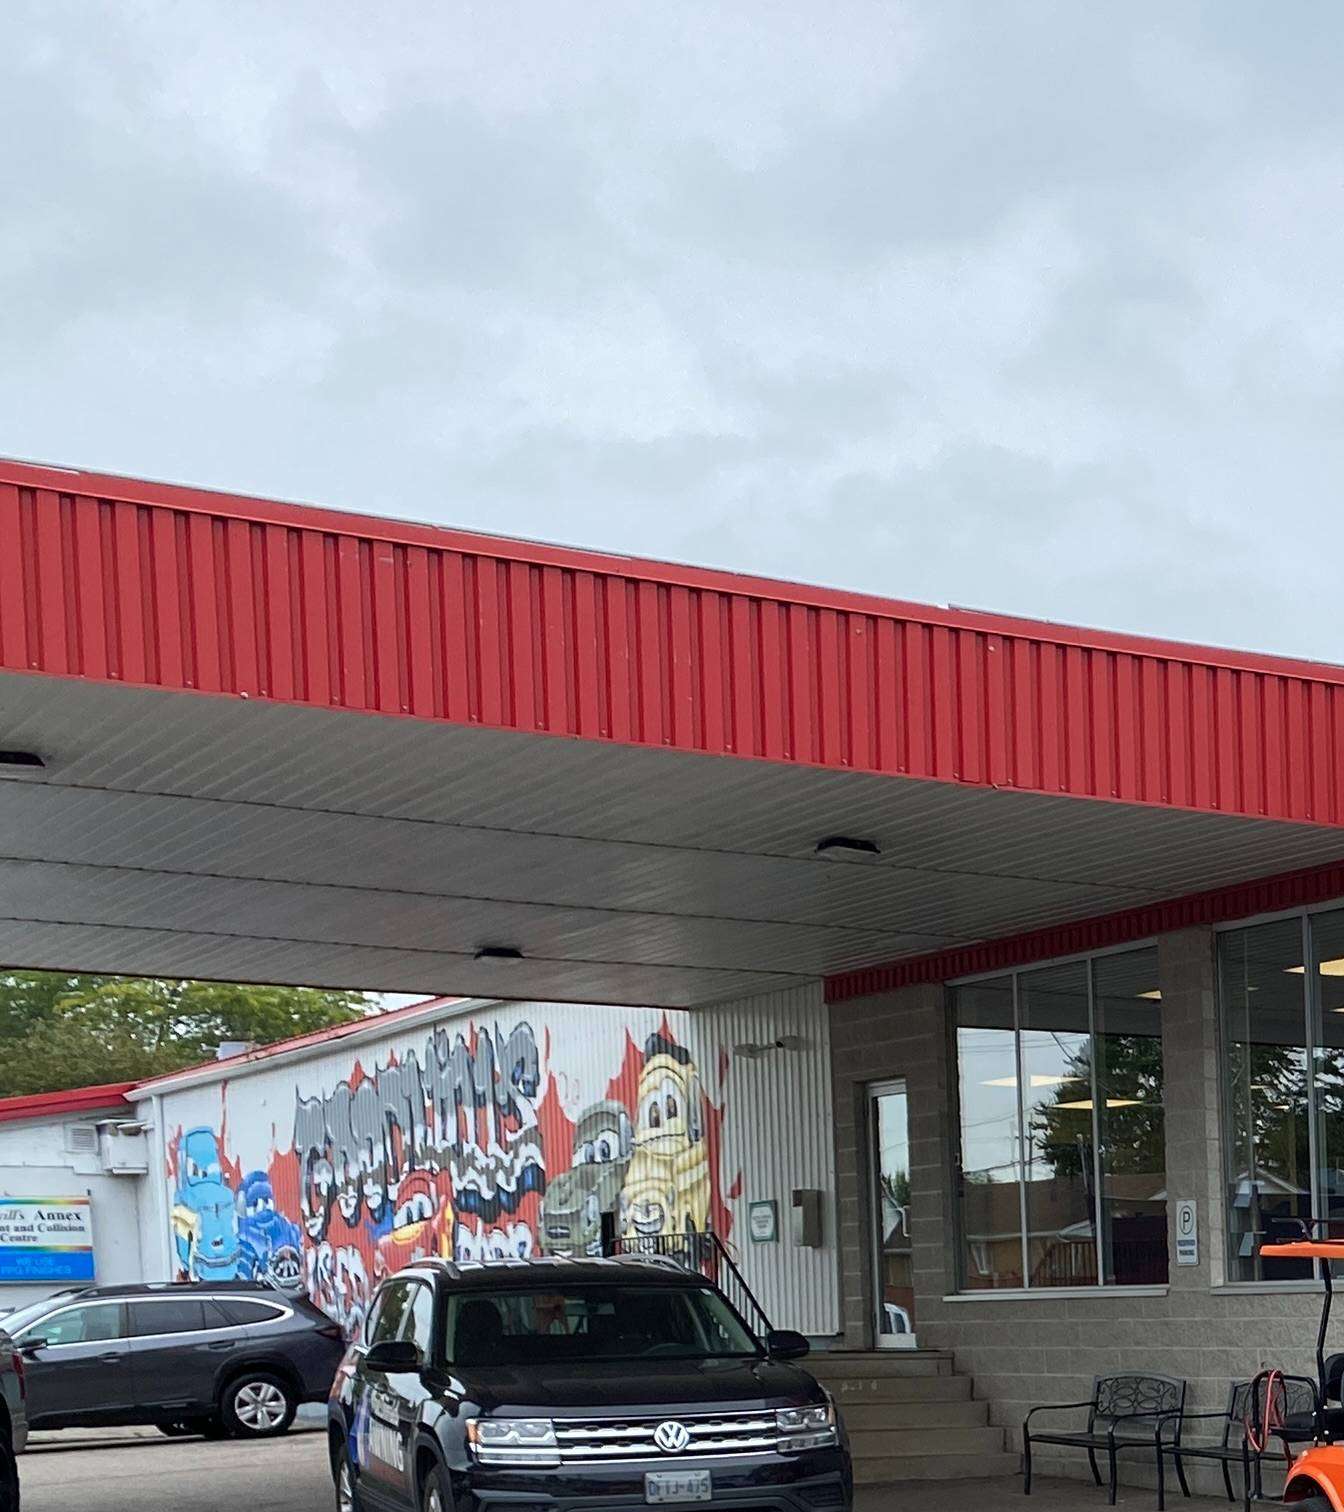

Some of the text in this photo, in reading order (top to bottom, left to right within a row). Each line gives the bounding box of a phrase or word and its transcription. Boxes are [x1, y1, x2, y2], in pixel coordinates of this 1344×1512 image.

[34, 1210, 82, 1221] Annex
[14, 1224, 34, 1233] and
[37, 1223, 86, 1233] Collision
[0, 1232, 38, 1242] Centre
